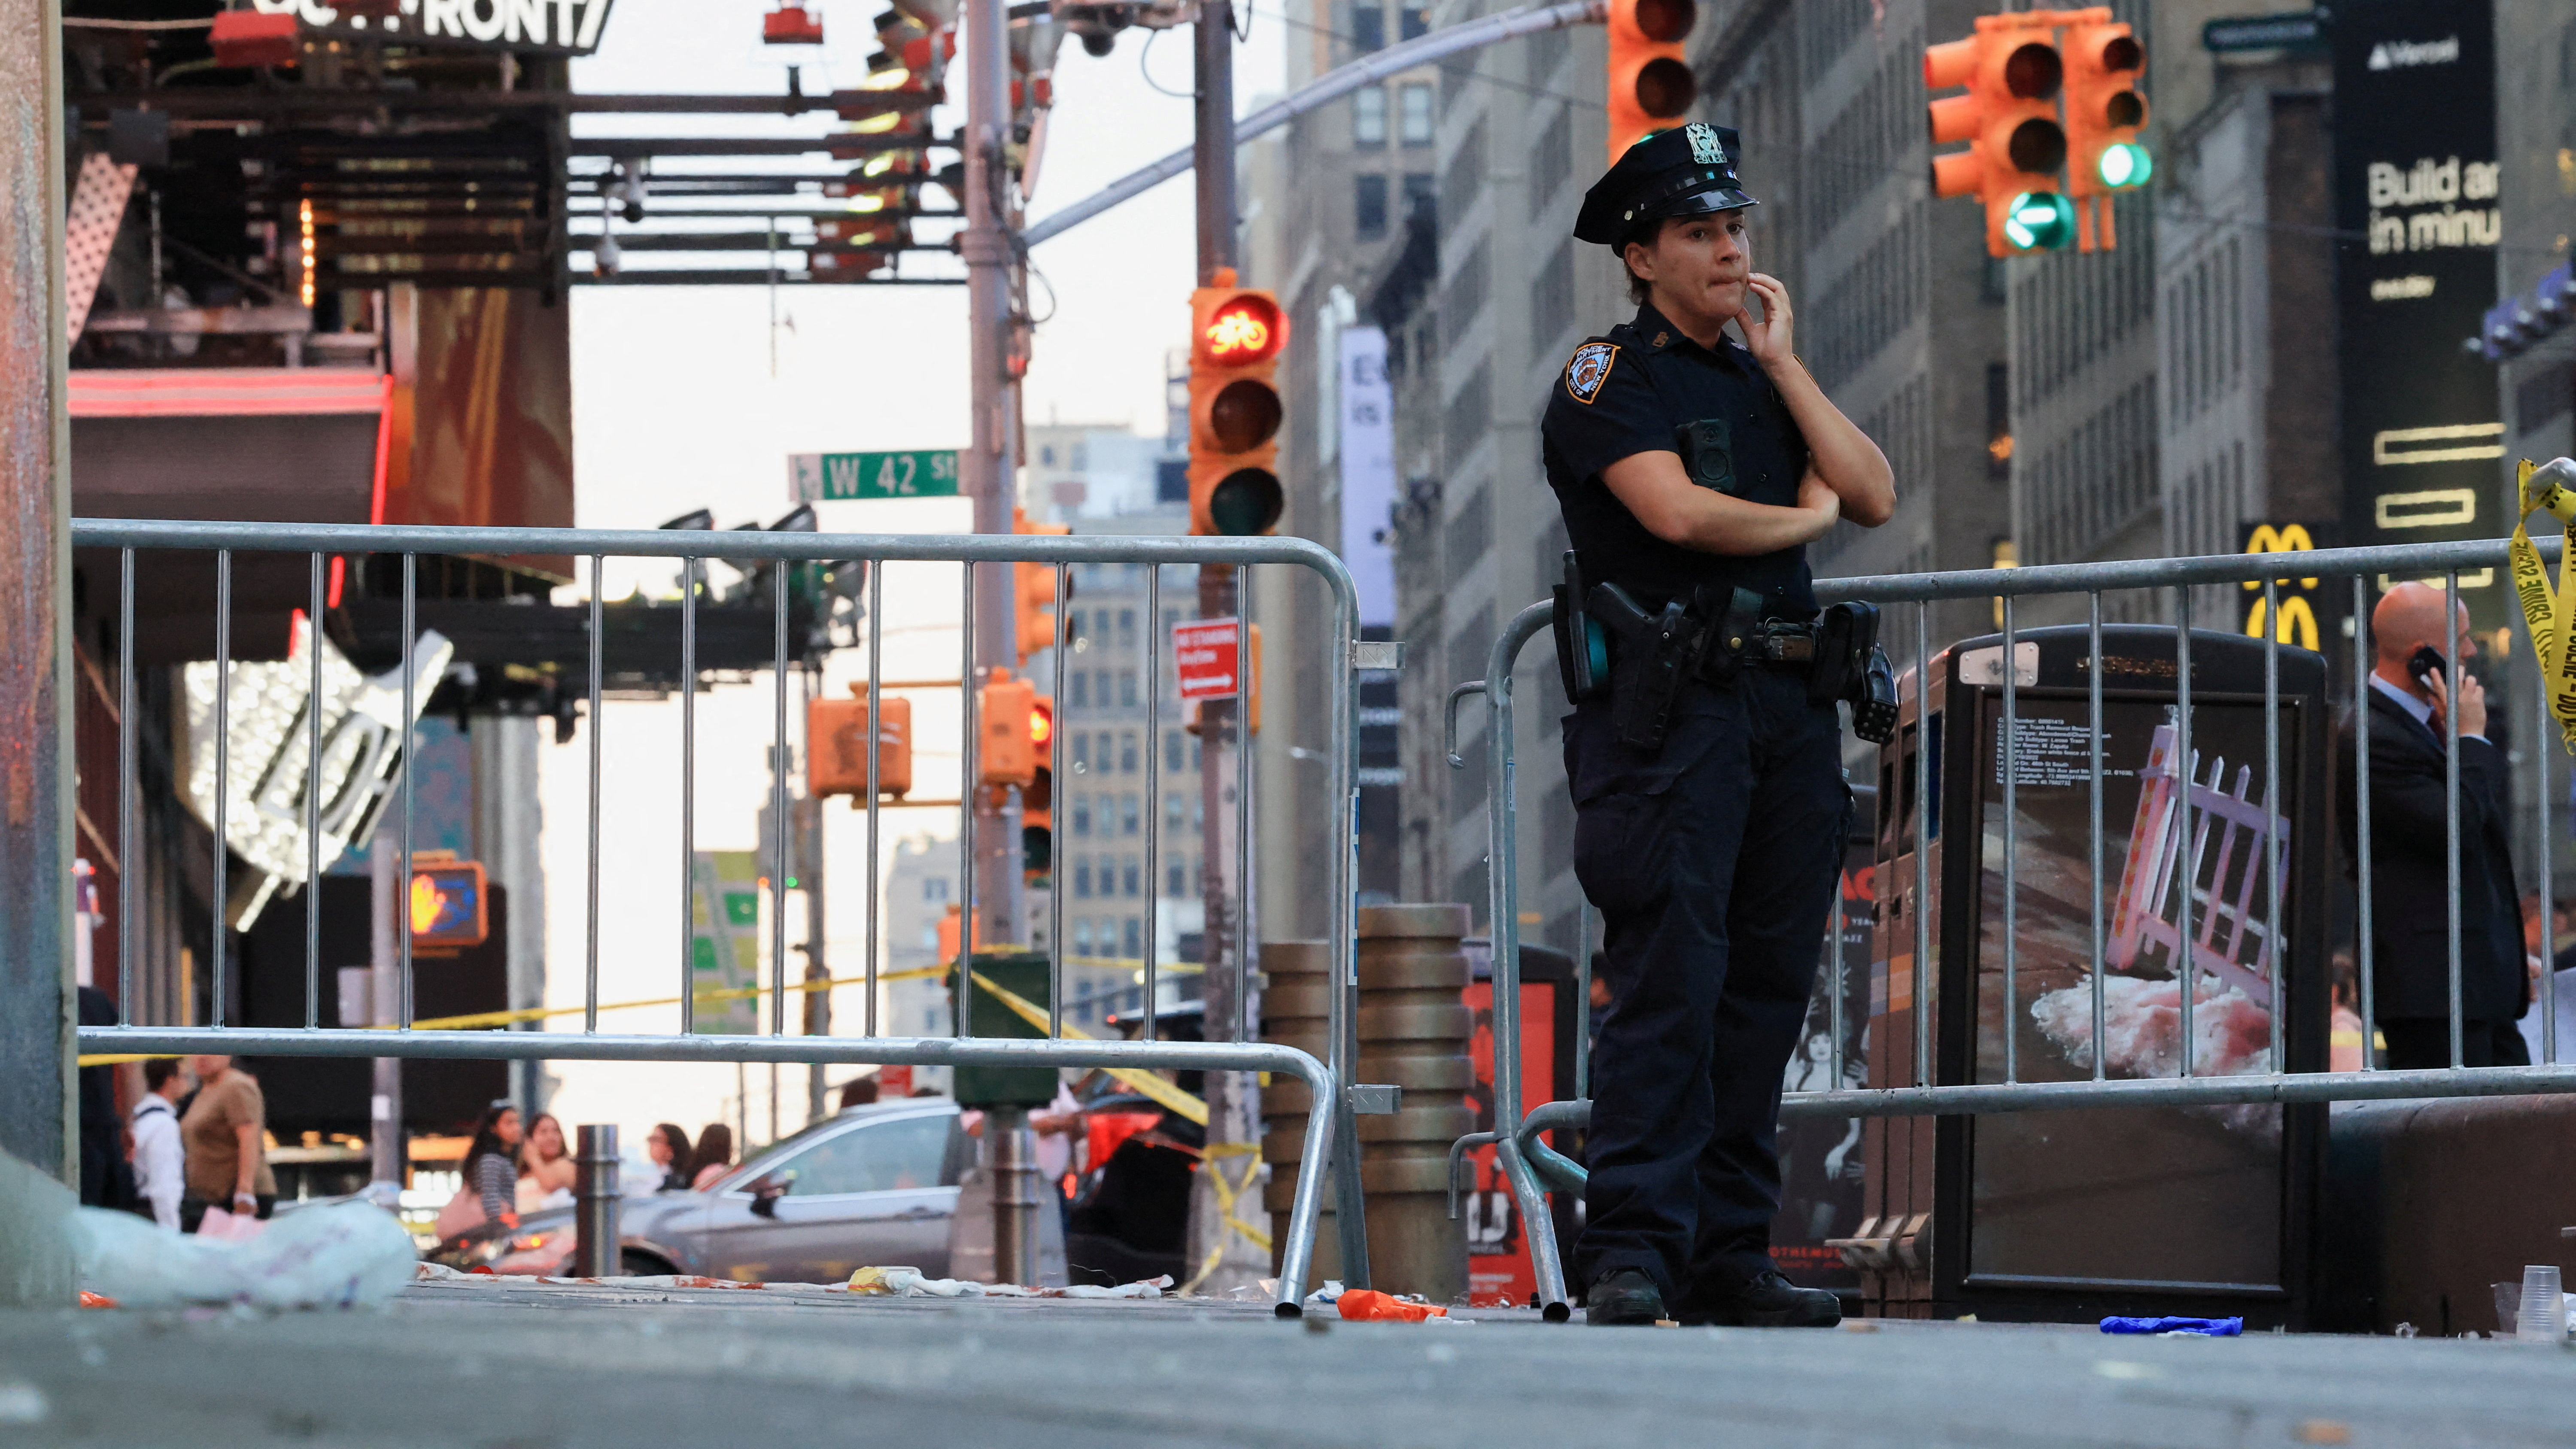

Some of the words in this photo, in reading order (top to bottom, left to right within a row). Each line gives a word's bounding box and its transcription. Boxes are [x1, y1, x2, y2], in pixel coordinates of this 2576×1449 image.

[2368, 157, 2460, 207] Build
[2369, 208, 2405, 254] in
[1569, 347, 1611, 374] DEPARTMENT
[1577, 345, 1604, 358] POLICE
[1590, 375, 1601, 391] NEW
[1599, 355, 1610, 374] YORK
[828, 458, 860, 496] W
[877, 454, 917, 494] 42
[1362, 647, 1396, 664] NY
